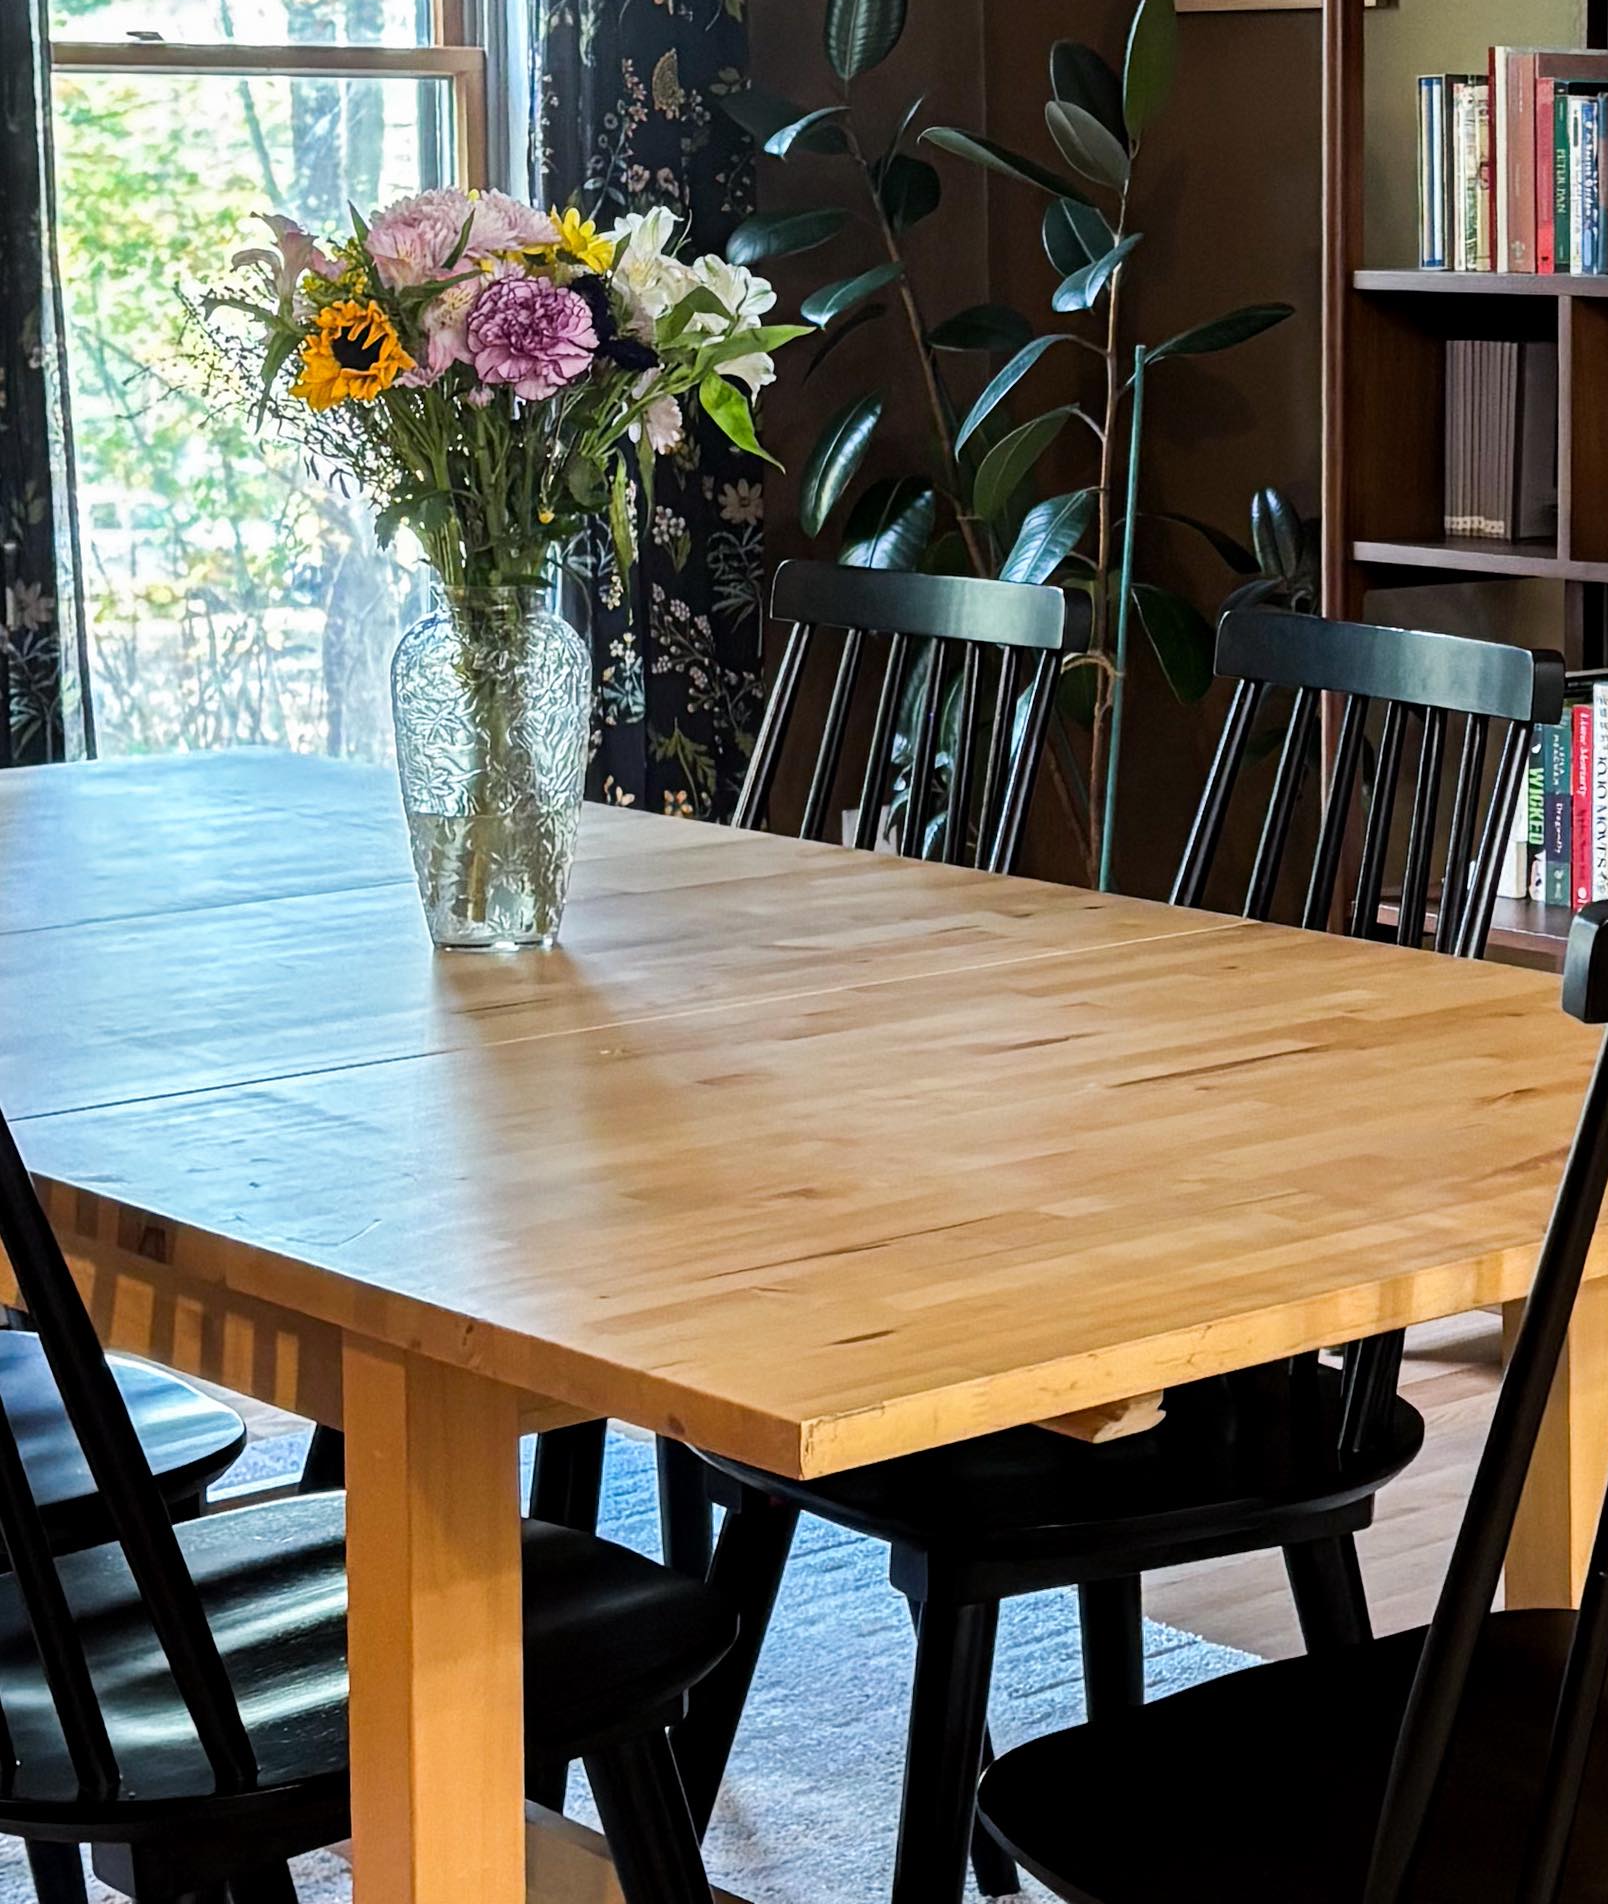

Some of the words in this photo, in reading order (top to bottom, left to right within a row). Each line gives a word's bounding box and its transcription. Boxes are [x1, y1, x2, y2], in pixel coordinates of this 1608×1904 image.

[1556, 148, 1567, 182] PETER
[1556, 185, 1567, 214] PAN
[1579, 712, 1588, 745] Liane
[1577, 748, 1588, 797] Moriarty
[1597, 756, 1608, 800] JOJO
[1529, 767, 1545, 846] WICKED
[1554, 802, 1562, 854] Dragonfly
